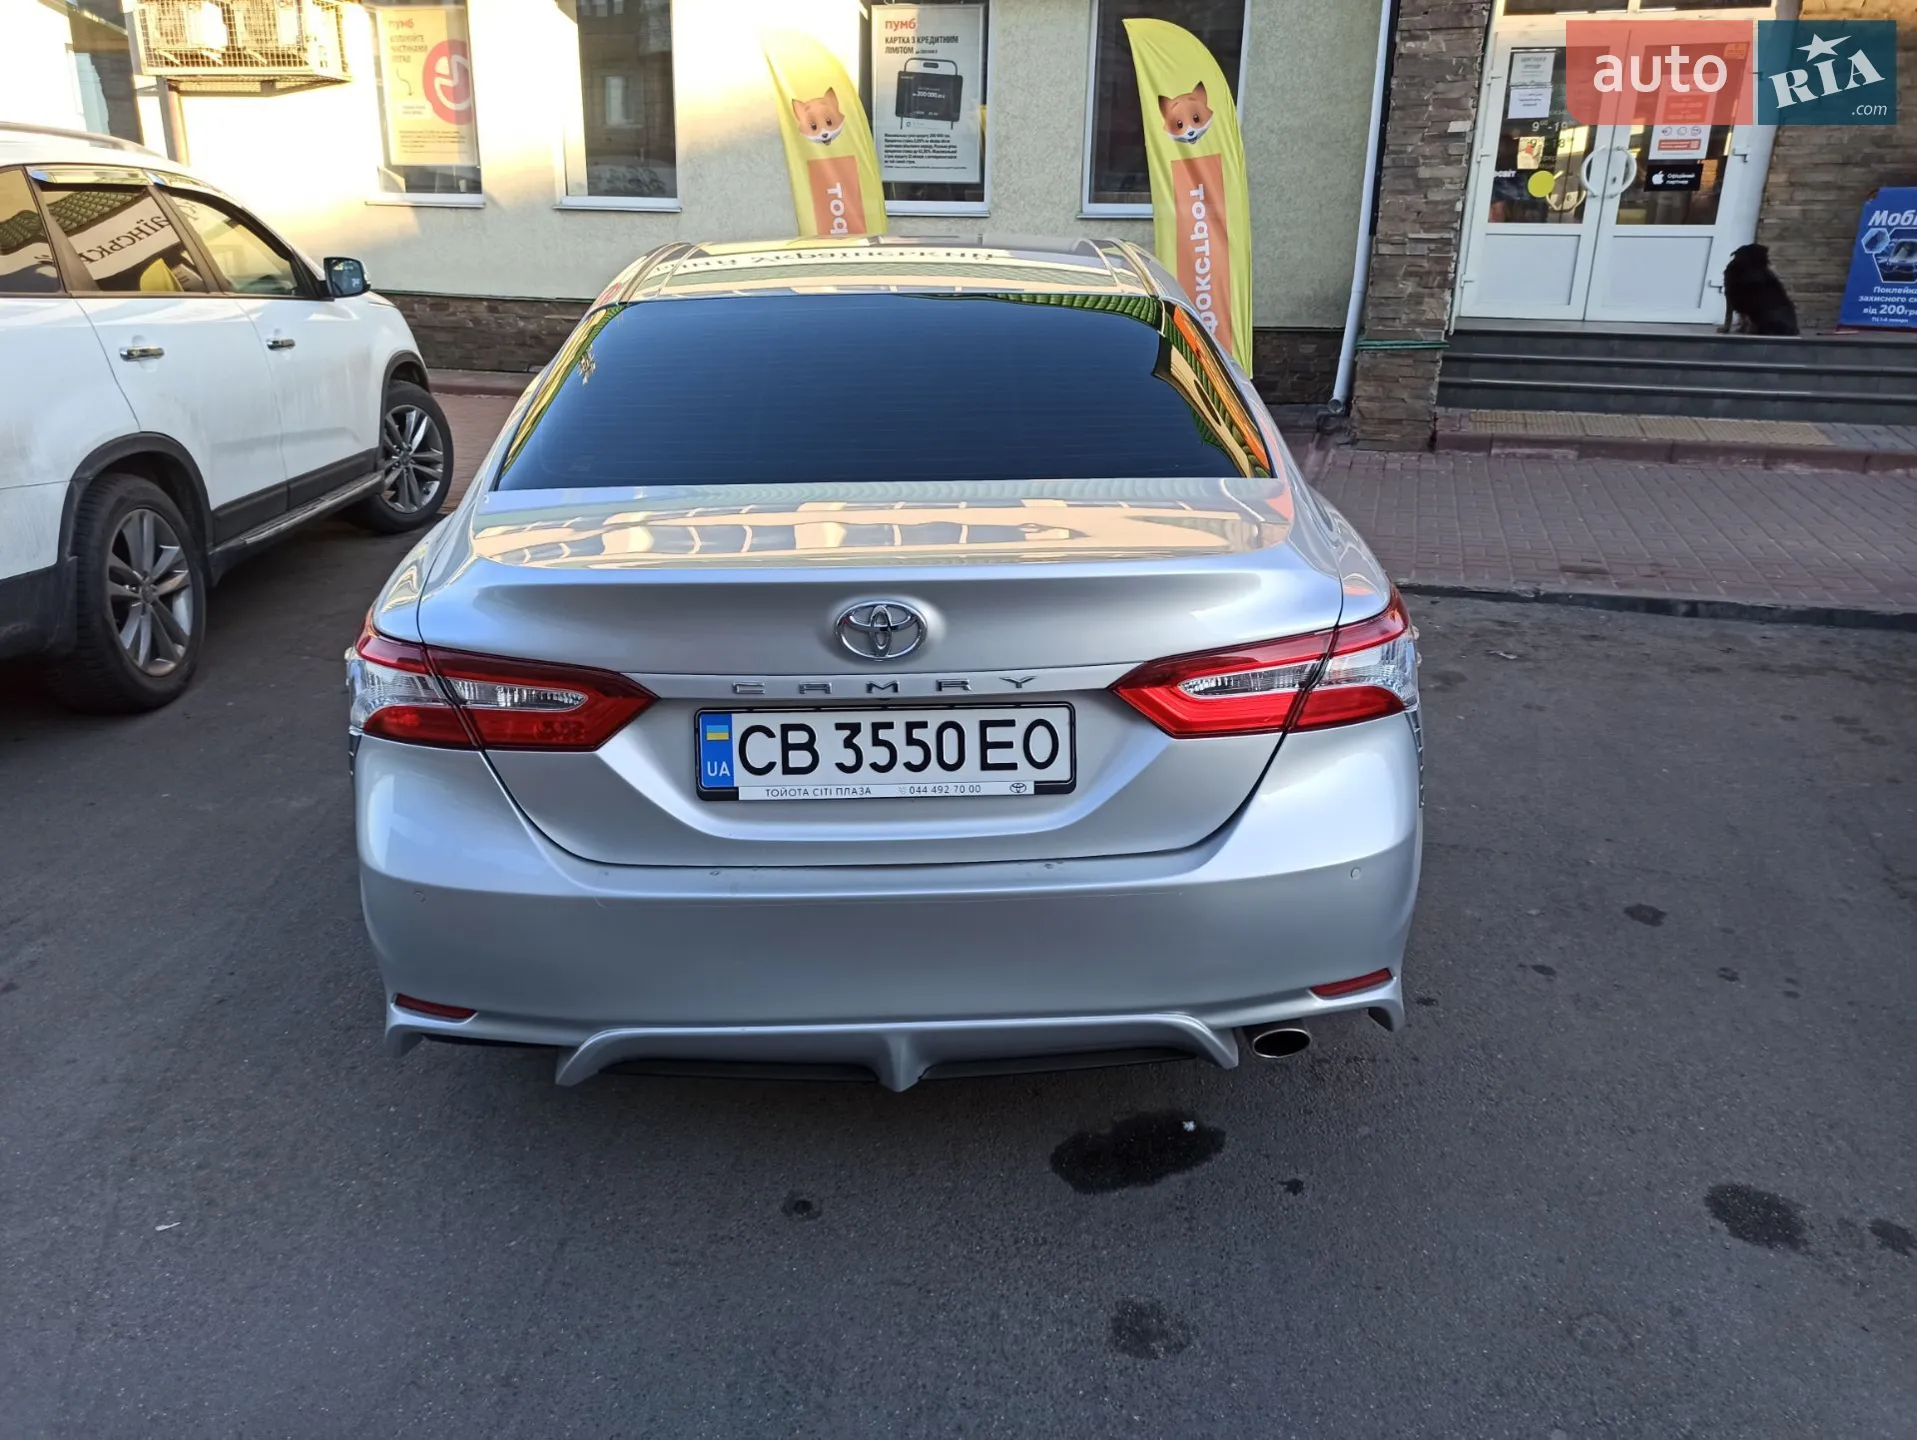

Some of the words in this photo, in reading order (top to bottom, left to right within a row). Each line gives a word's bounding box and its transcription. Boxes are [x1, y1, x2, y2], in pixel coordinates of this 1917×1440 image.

[885, 18, 917, 31] пумб
[885, 36, 910, 44] КАРТКА
[917, 35, 959, 45] КРЕДИТНИМ
[885, 46, 914, 54] ЛІМІТОМ
[1868, 210, 1917, 226] Моб
[1190, 184, 1218, 335] фокстрот
[1858, 295, 1906, 303] захисного
[1863, 304, 1877, 314] від
[733, 675, 1037, 694] CAMRY
[738, 723, 820, 776] CB
[834, 721, 965, 773] 3550
[979, 719, 1059, 771] EO
[707, 761, 731, 777] UA
[765, 788, 810, 797] ТОЙОТА
[813, 787, 833, 796] СІТІ
[836, 786, 872, 796] ПЛАЗА
[909, 786, 927, 795] 044
[931, 785, 950, 794] 492
[954, 785, 965, 794] 70
[968, 785, 981, 793] 00
